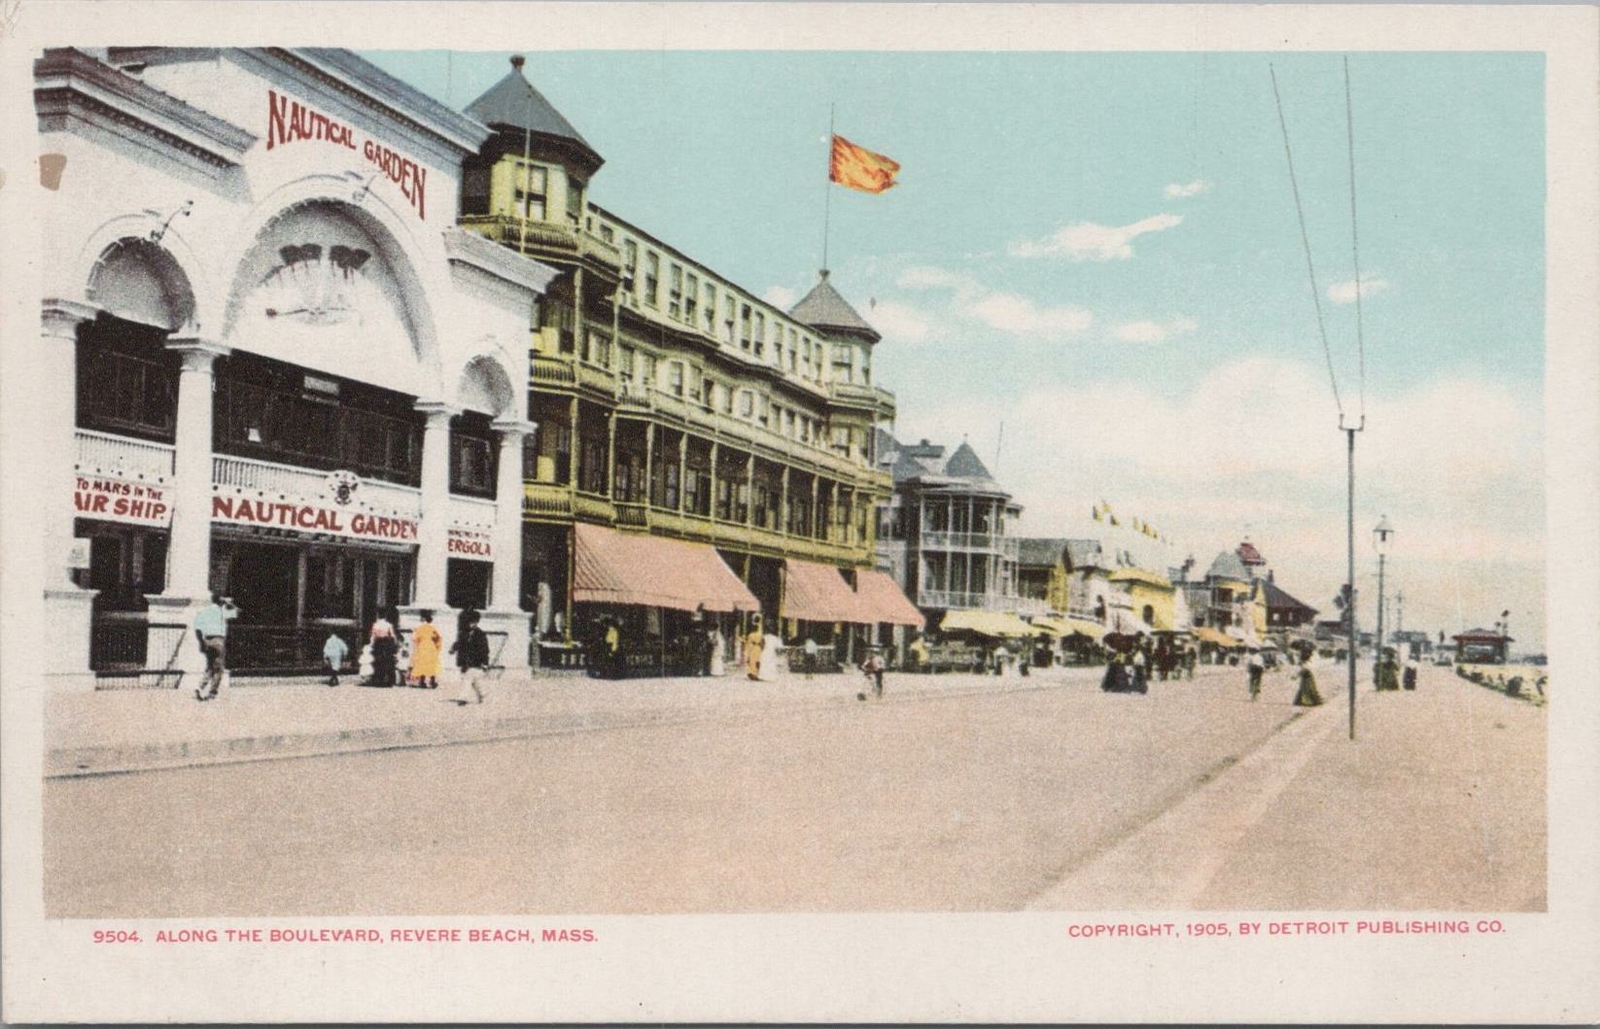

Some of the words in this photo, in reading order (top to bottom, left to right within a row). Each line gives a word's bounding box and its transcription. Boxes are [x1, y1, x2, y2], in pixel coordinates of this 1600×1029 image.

[266, 90, 357, 151] NAUTICAL
[363, 139, 427, 221] GARDEN
[92, 480, 131, 496] MARS
[134, 485, 144, 497] IN
[146, 487, 163, 501] THE
[212, 496, 343, 532] NAUTICAL
[351, 513, 418, 540] GARDEN
